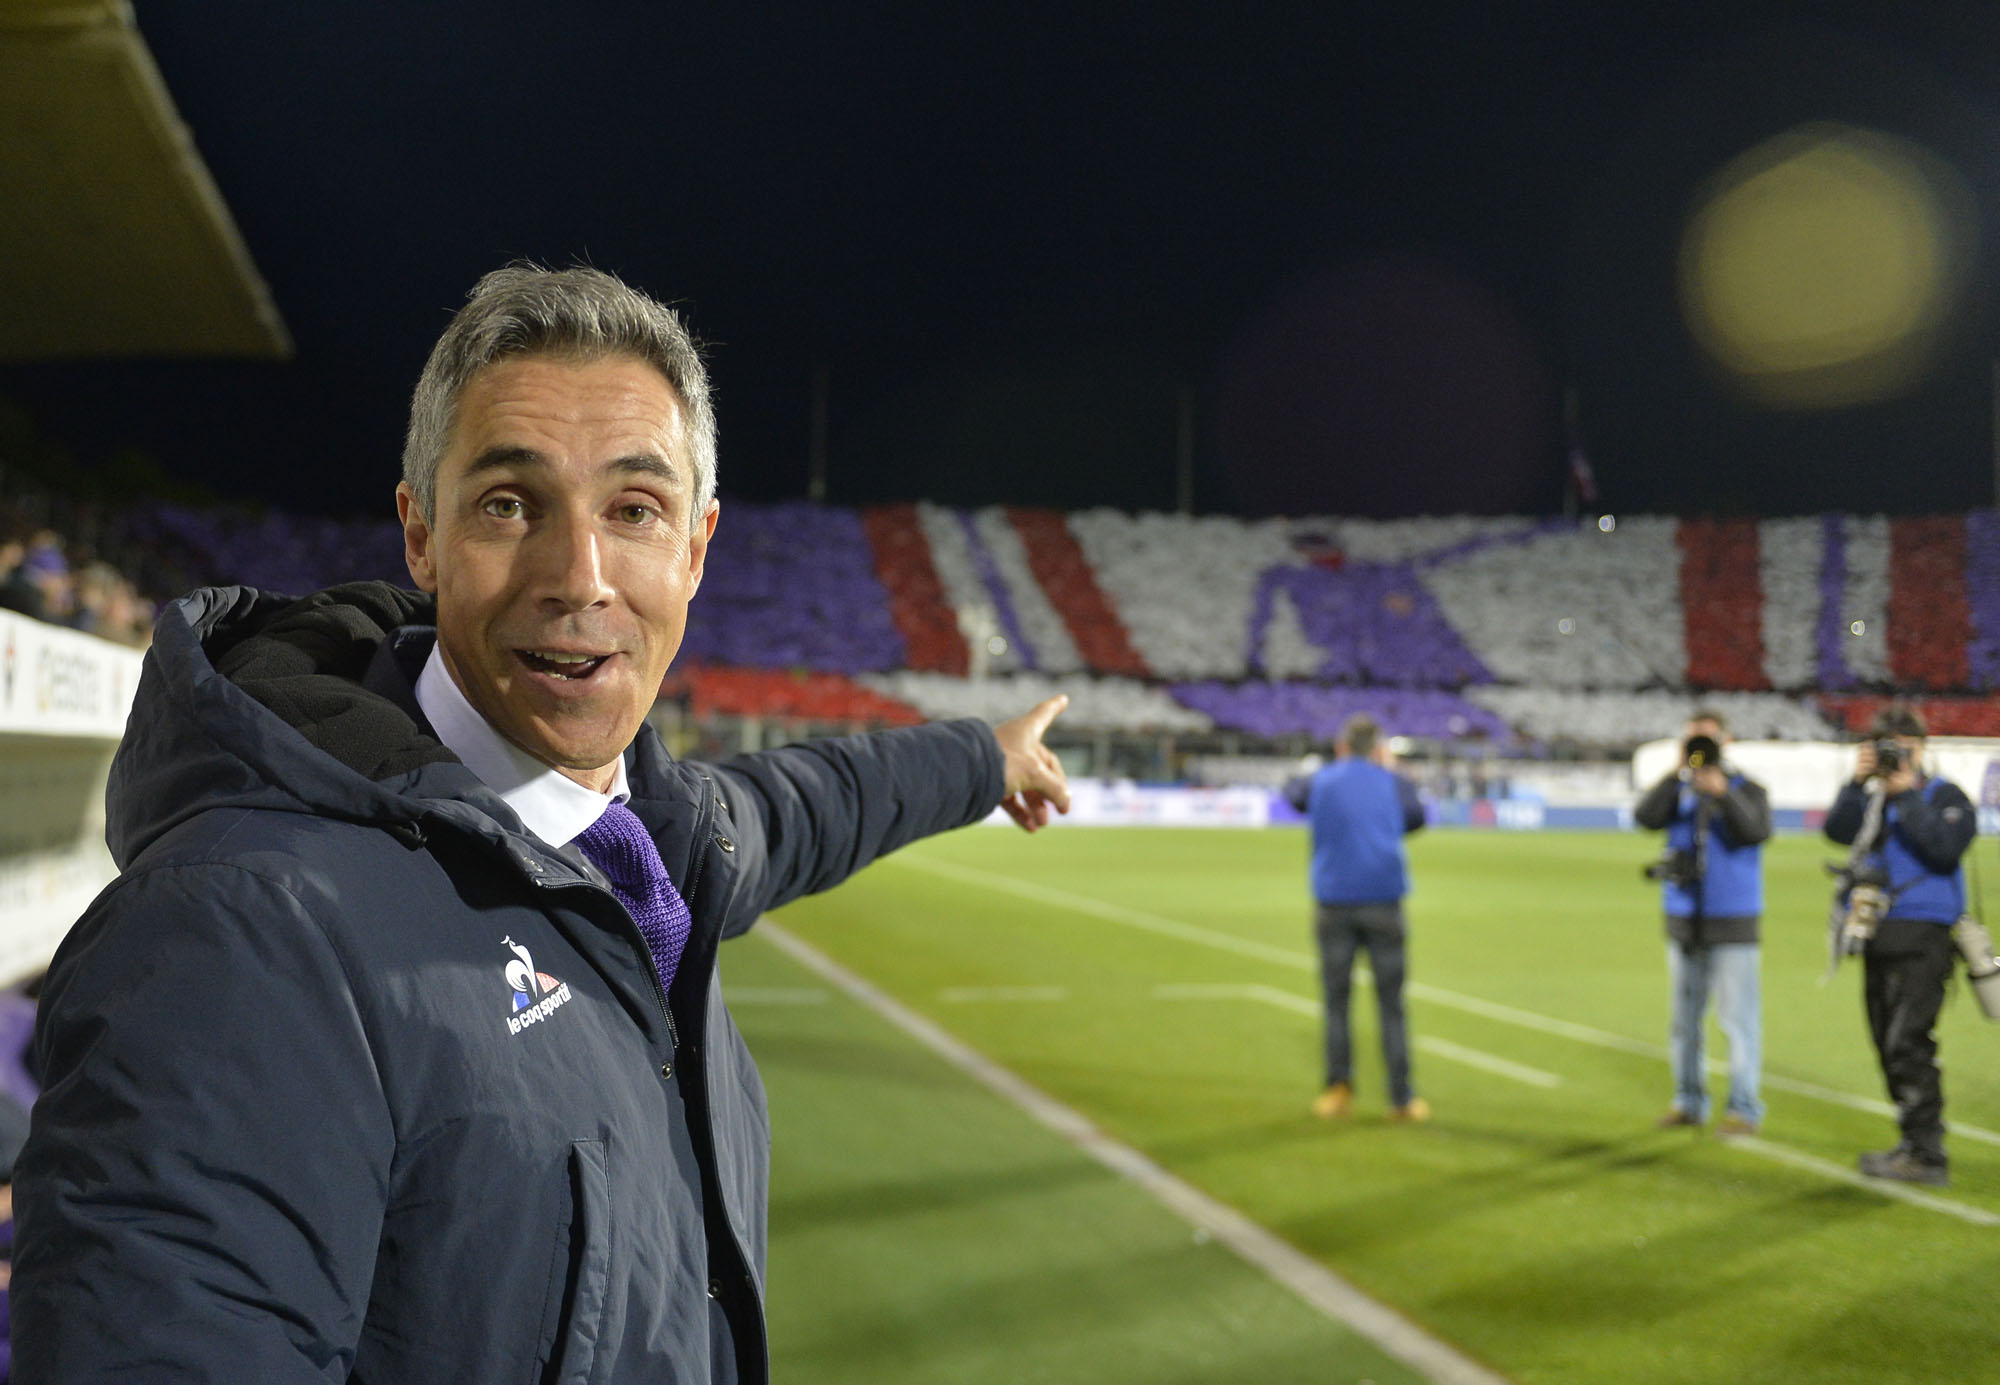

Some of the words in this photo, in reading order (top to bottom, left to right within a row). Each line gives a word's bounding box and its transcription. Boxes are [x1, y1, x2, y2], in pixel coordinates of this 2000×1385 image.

[506, 1017, 521, 1035] le
[519, 1004, 545, 1028] coq
[540, 982, 572, 1016] sportif
